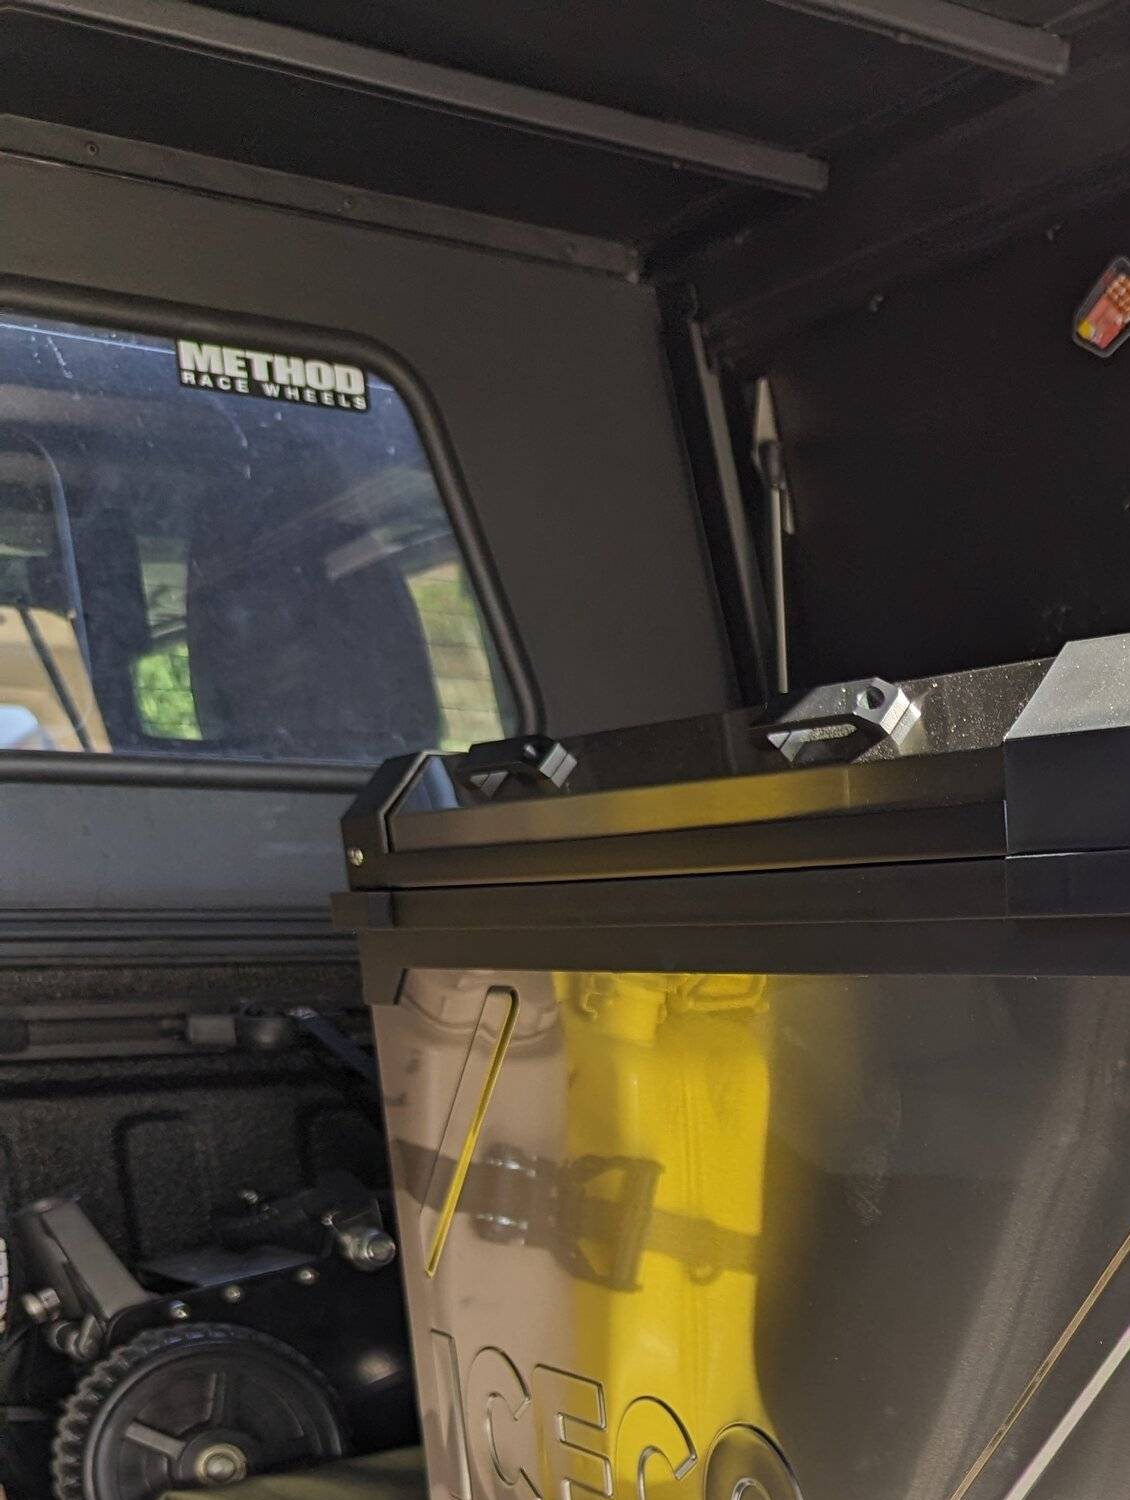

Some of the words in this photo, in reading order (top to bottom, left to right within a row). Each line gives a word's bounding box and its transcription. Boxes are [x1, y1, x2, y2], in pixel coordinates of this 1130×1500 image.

[177, 339, 365, 395] METHOD
[181, 371, 249, 393] RACE
[262, 383, 366, 410] WHEELS
